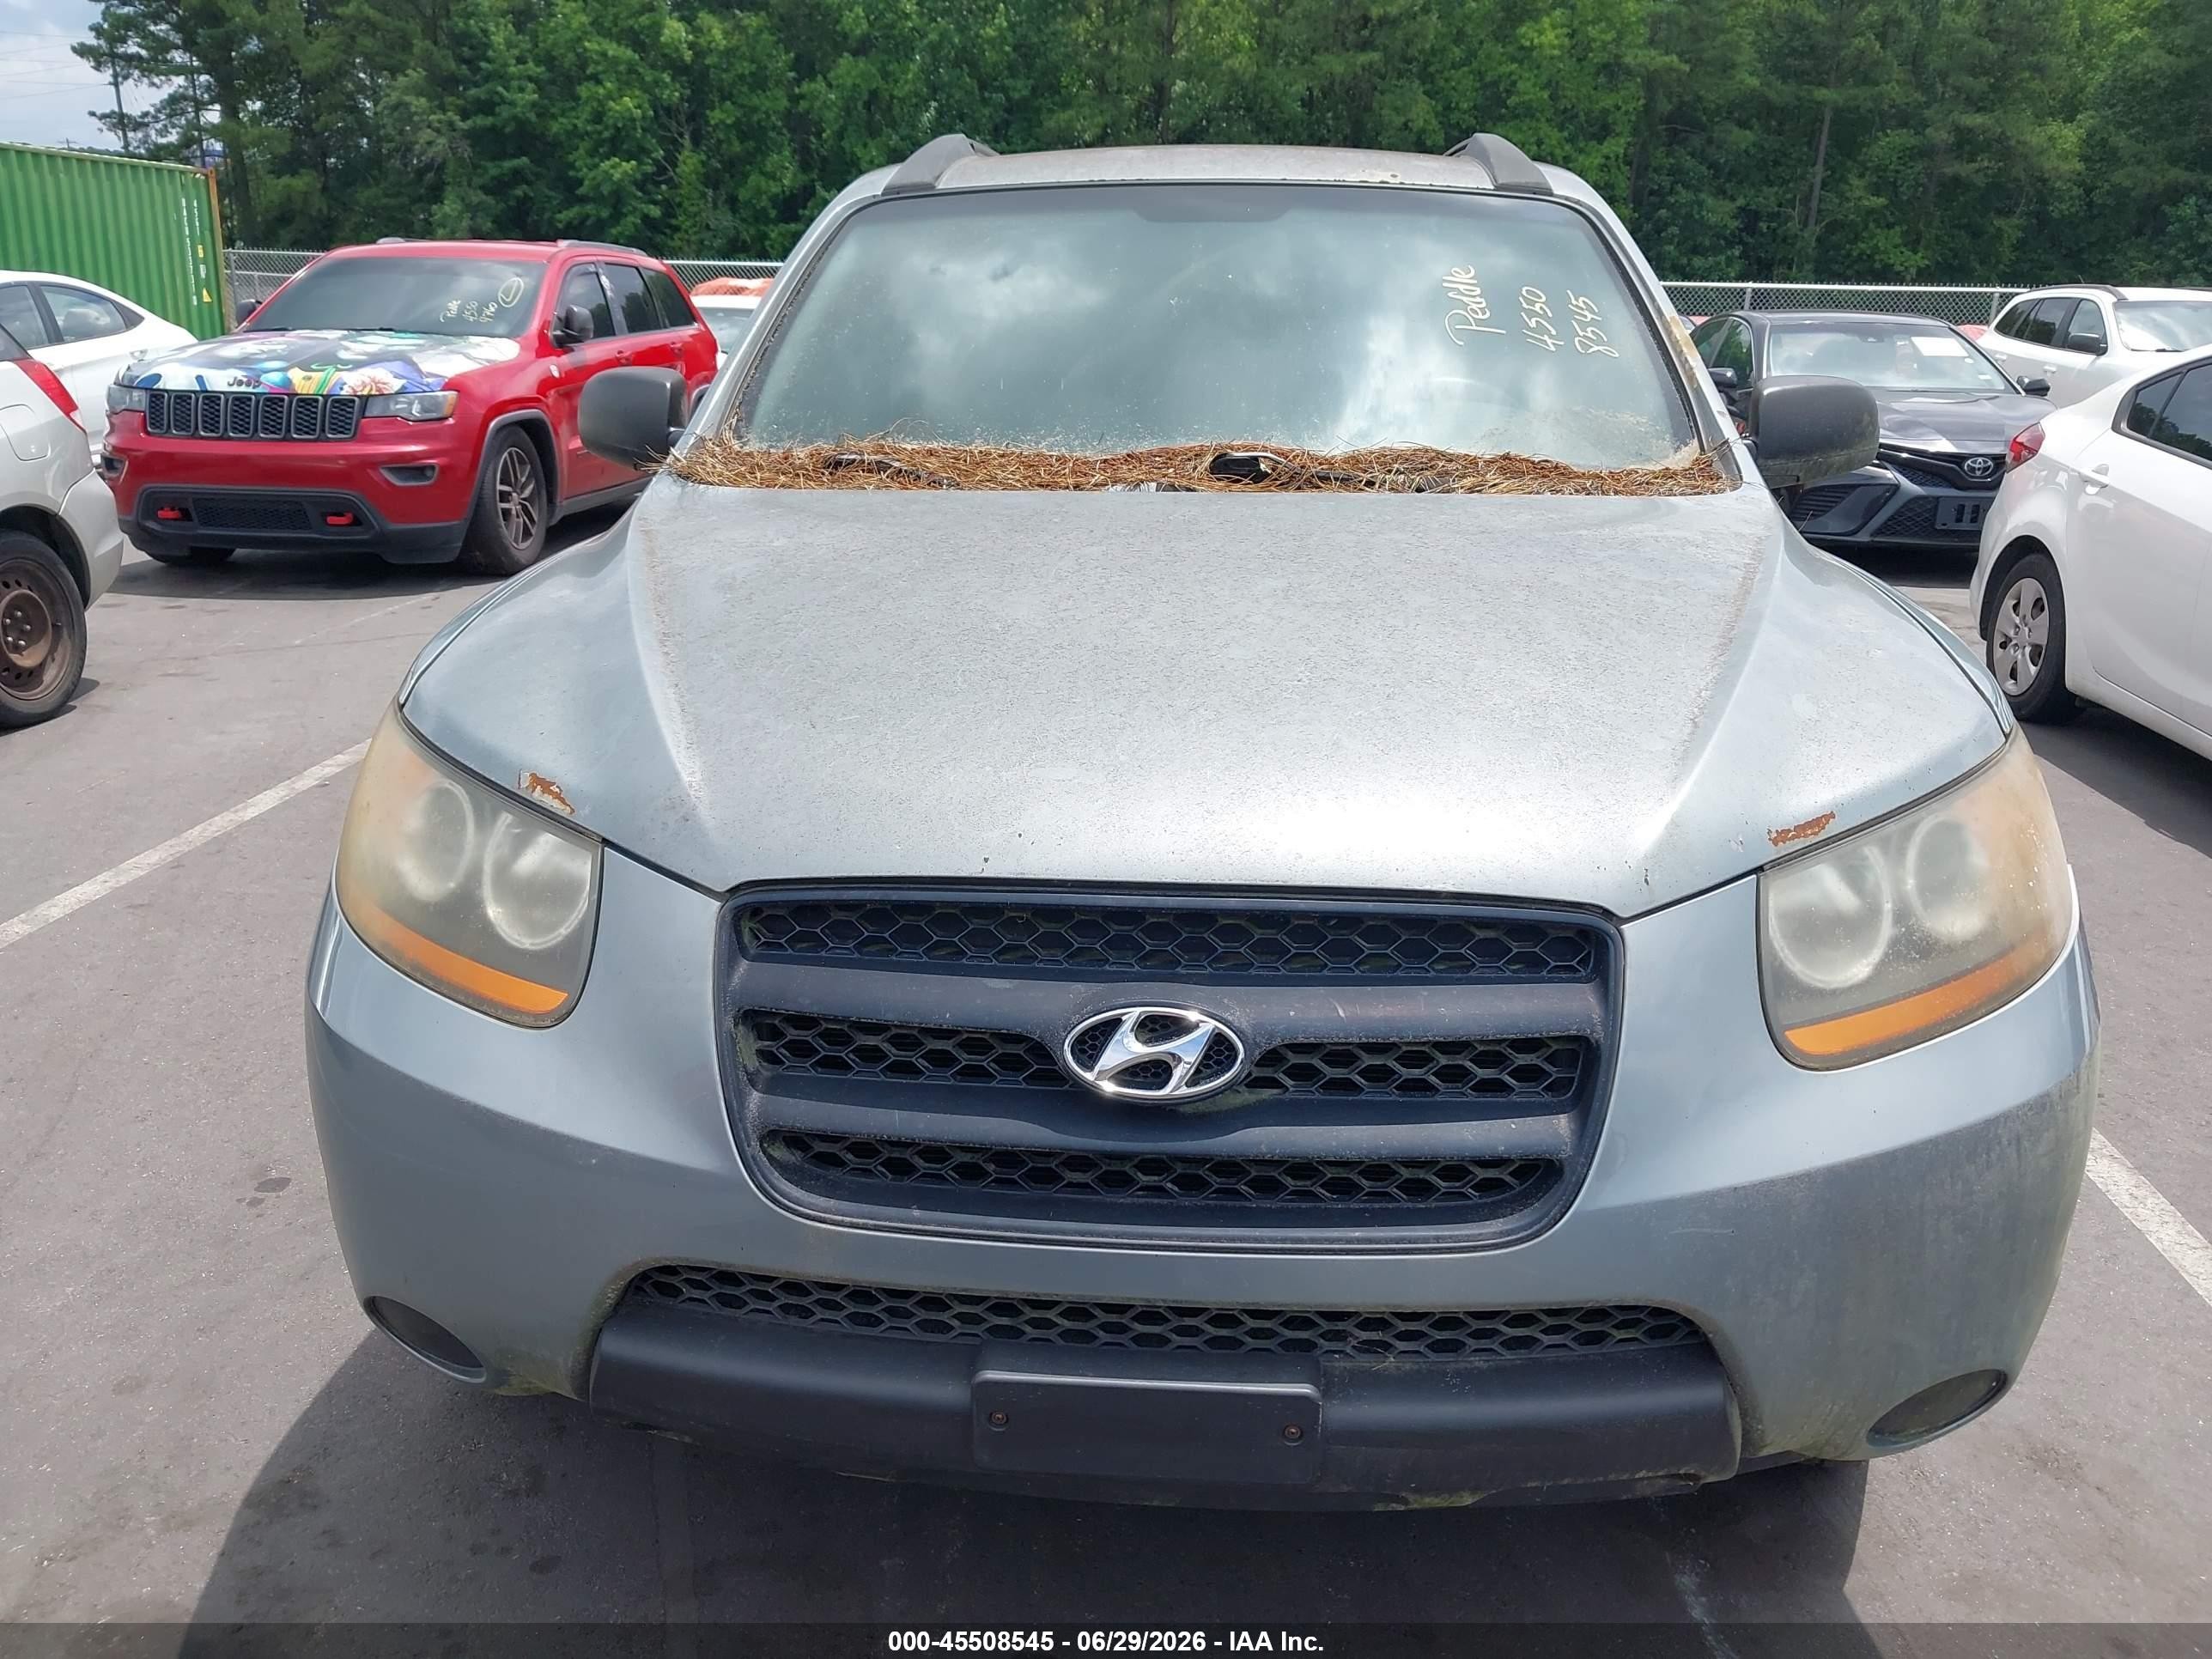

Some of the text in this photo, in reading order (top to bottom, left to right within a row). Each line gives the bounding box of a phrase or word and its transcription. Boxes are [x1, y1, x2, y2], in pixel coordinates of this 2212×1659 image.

[1442, 265, 1506, 345] Peddle
[1519, 286, 1565, 351] 4550
[1567, 290, 1620, 357] 8545
[227, 376, 262, 389] Jeep
